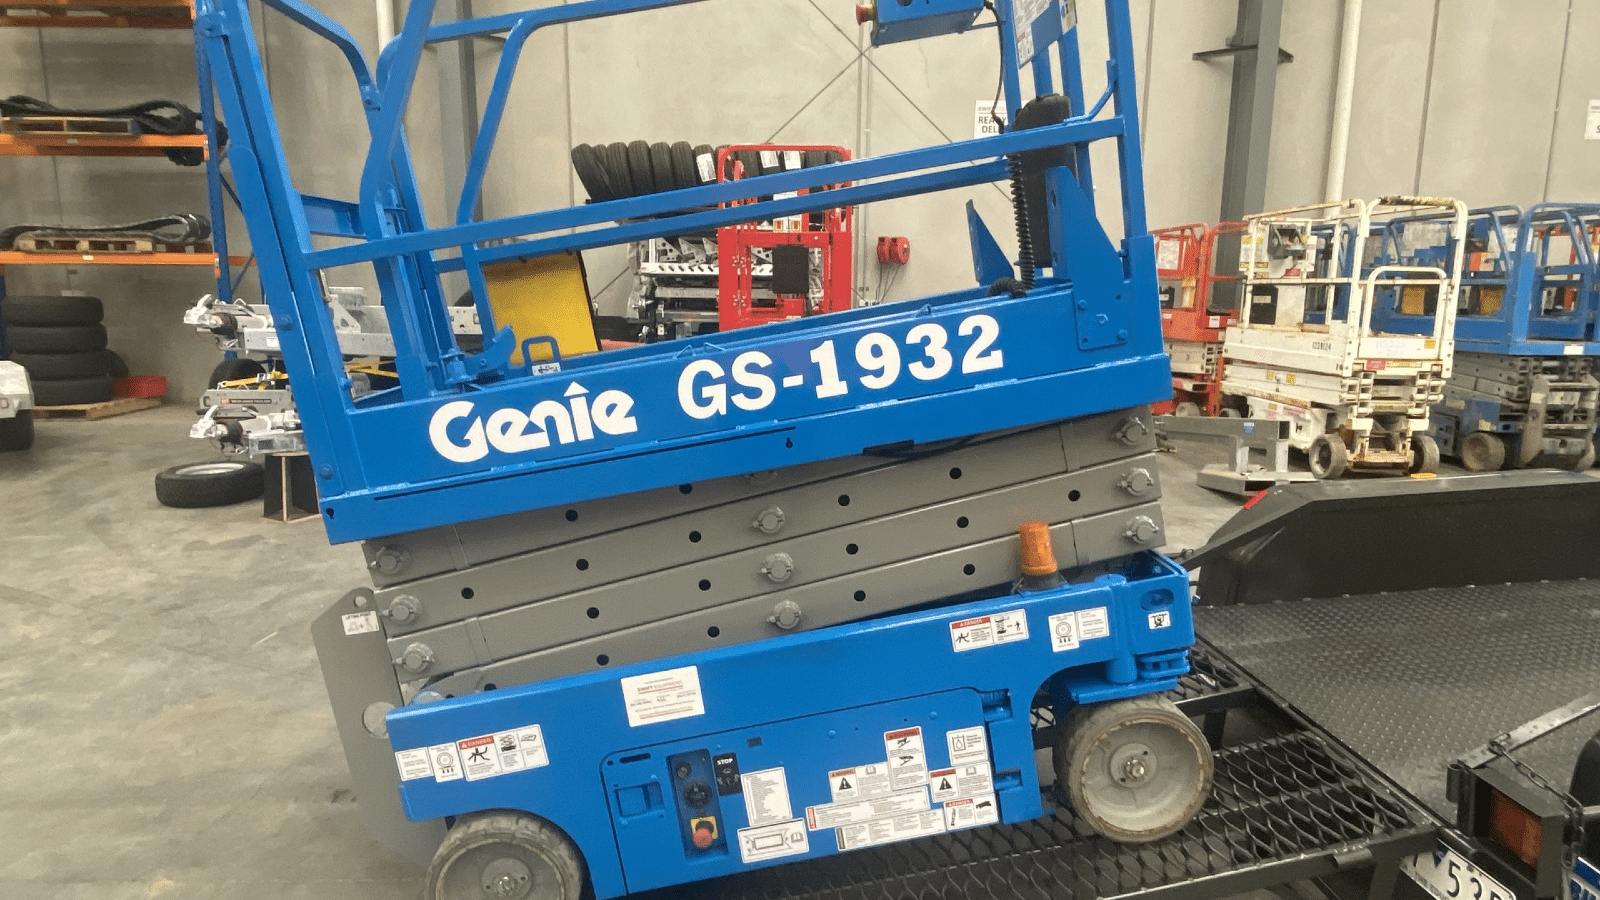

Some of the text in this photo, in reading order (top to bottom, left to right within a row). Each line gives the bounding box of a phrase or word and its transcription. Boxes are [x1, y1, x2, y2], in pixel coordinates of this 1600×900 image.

[429, 314, 1004, 463] Genie GS-1932
[716, 757, 734, 766] STOP
